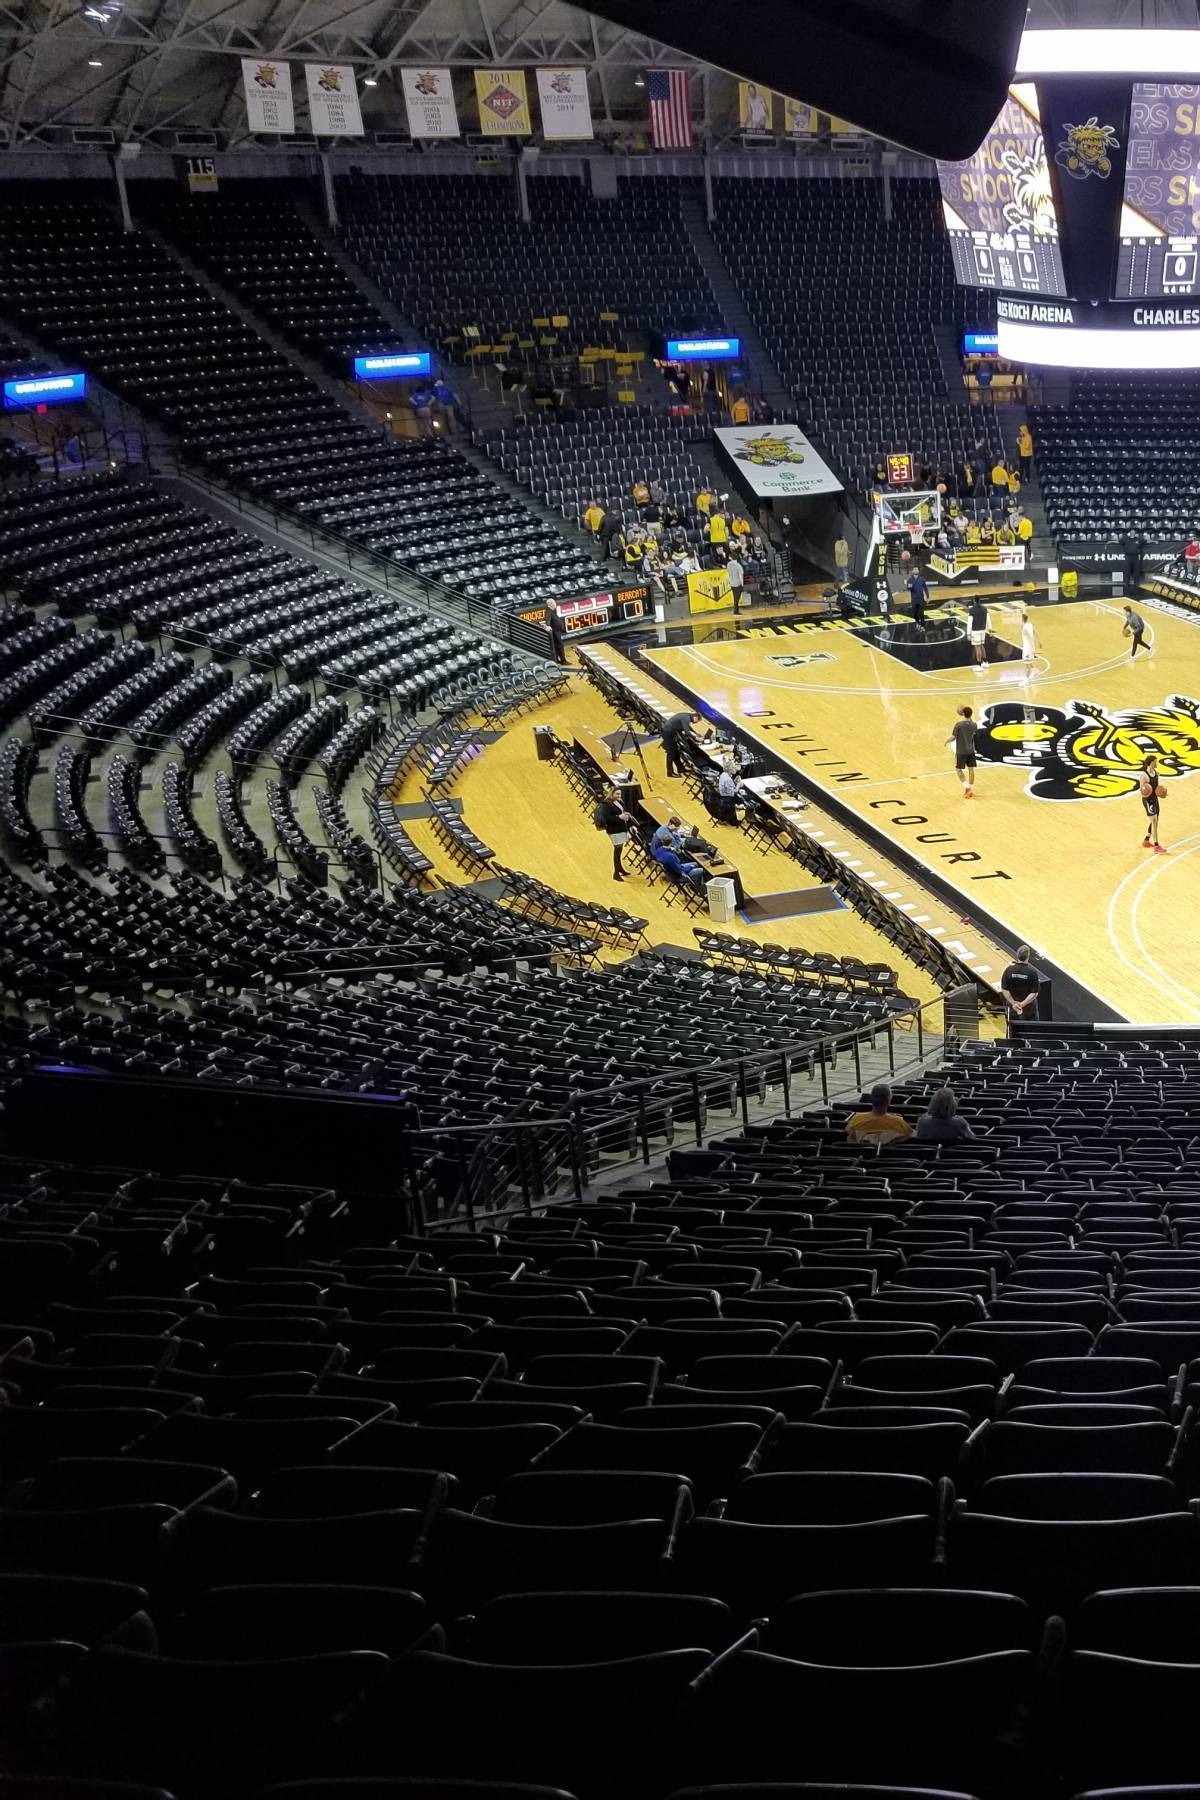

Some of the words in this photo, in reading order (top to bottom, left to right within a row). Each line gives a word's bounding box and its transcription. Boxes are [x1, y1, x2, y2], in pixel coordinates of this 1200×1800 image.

[489, 73, 511, 84] 2011
[492, 100, 514, 108] NIT
[187, 159, 215, 175] 115
[1174, 257, 1186, 276] 0
[1008, 301, 1030, 320] KOCH
[1031, 304, 1074, 323] ARENA
[1133, 308, 1200, 325] CHARLES
[893, 465, 908, 480] 23
[762, 478, 823, 488] Commerce
[878, 545, 887, 575] WSU
[617, 587, 647, 602] BEARCATS
[565, 611, 598, 630] 45:40
[738, 614, 915, 639] WICHITA
[748, 709, 869, 783] DEVLIN
[869, 798, 1013, 882] COURT
